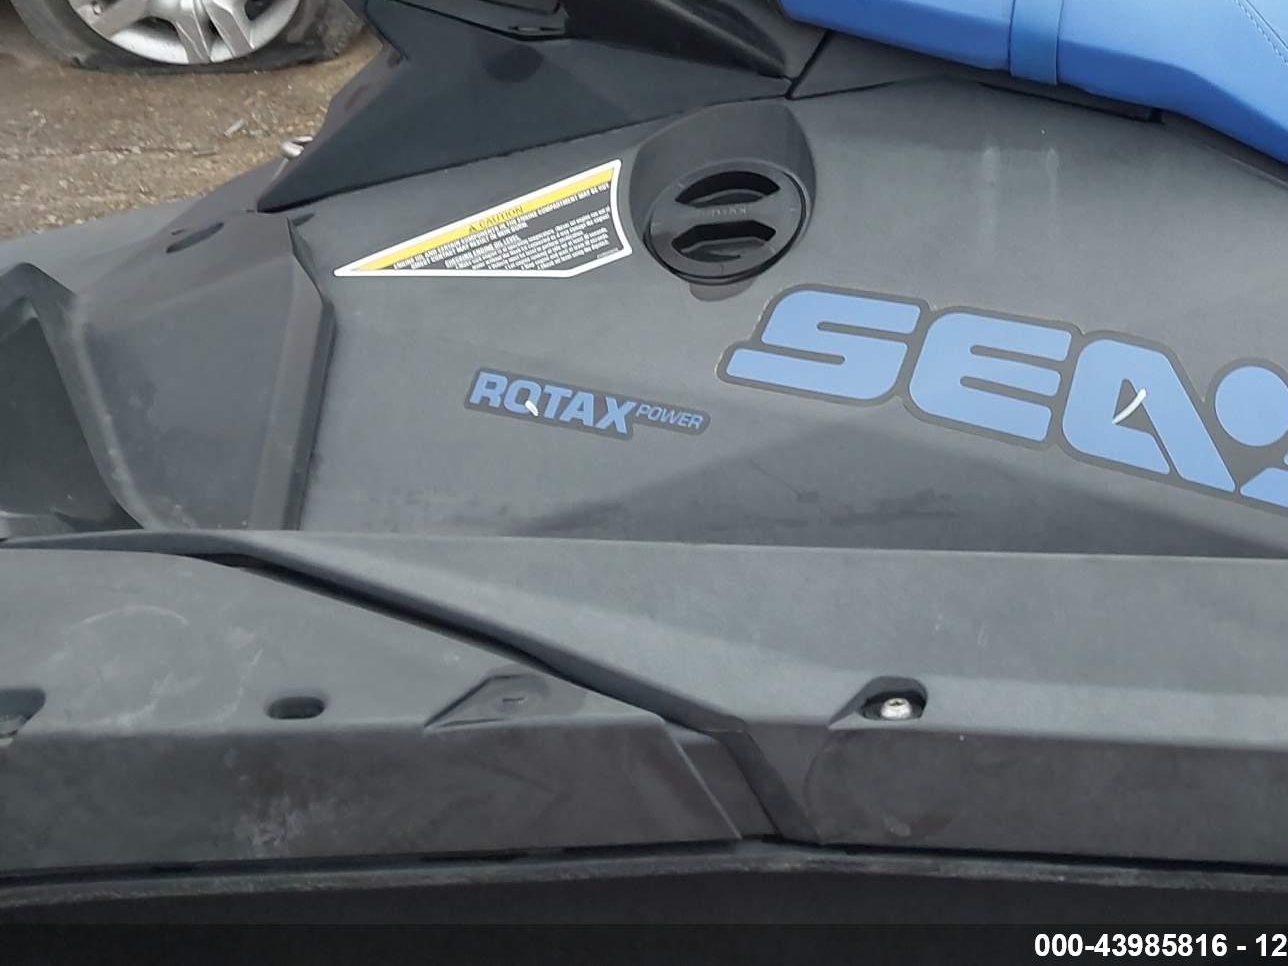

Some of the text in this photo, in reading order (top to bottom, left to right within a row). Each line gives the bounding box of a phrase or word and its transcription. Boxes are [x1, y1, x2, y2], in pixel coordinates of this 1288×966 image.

[475, 205, 523, 230] CAUTION
[469, 371, 704, 433] ROTAX POWER
